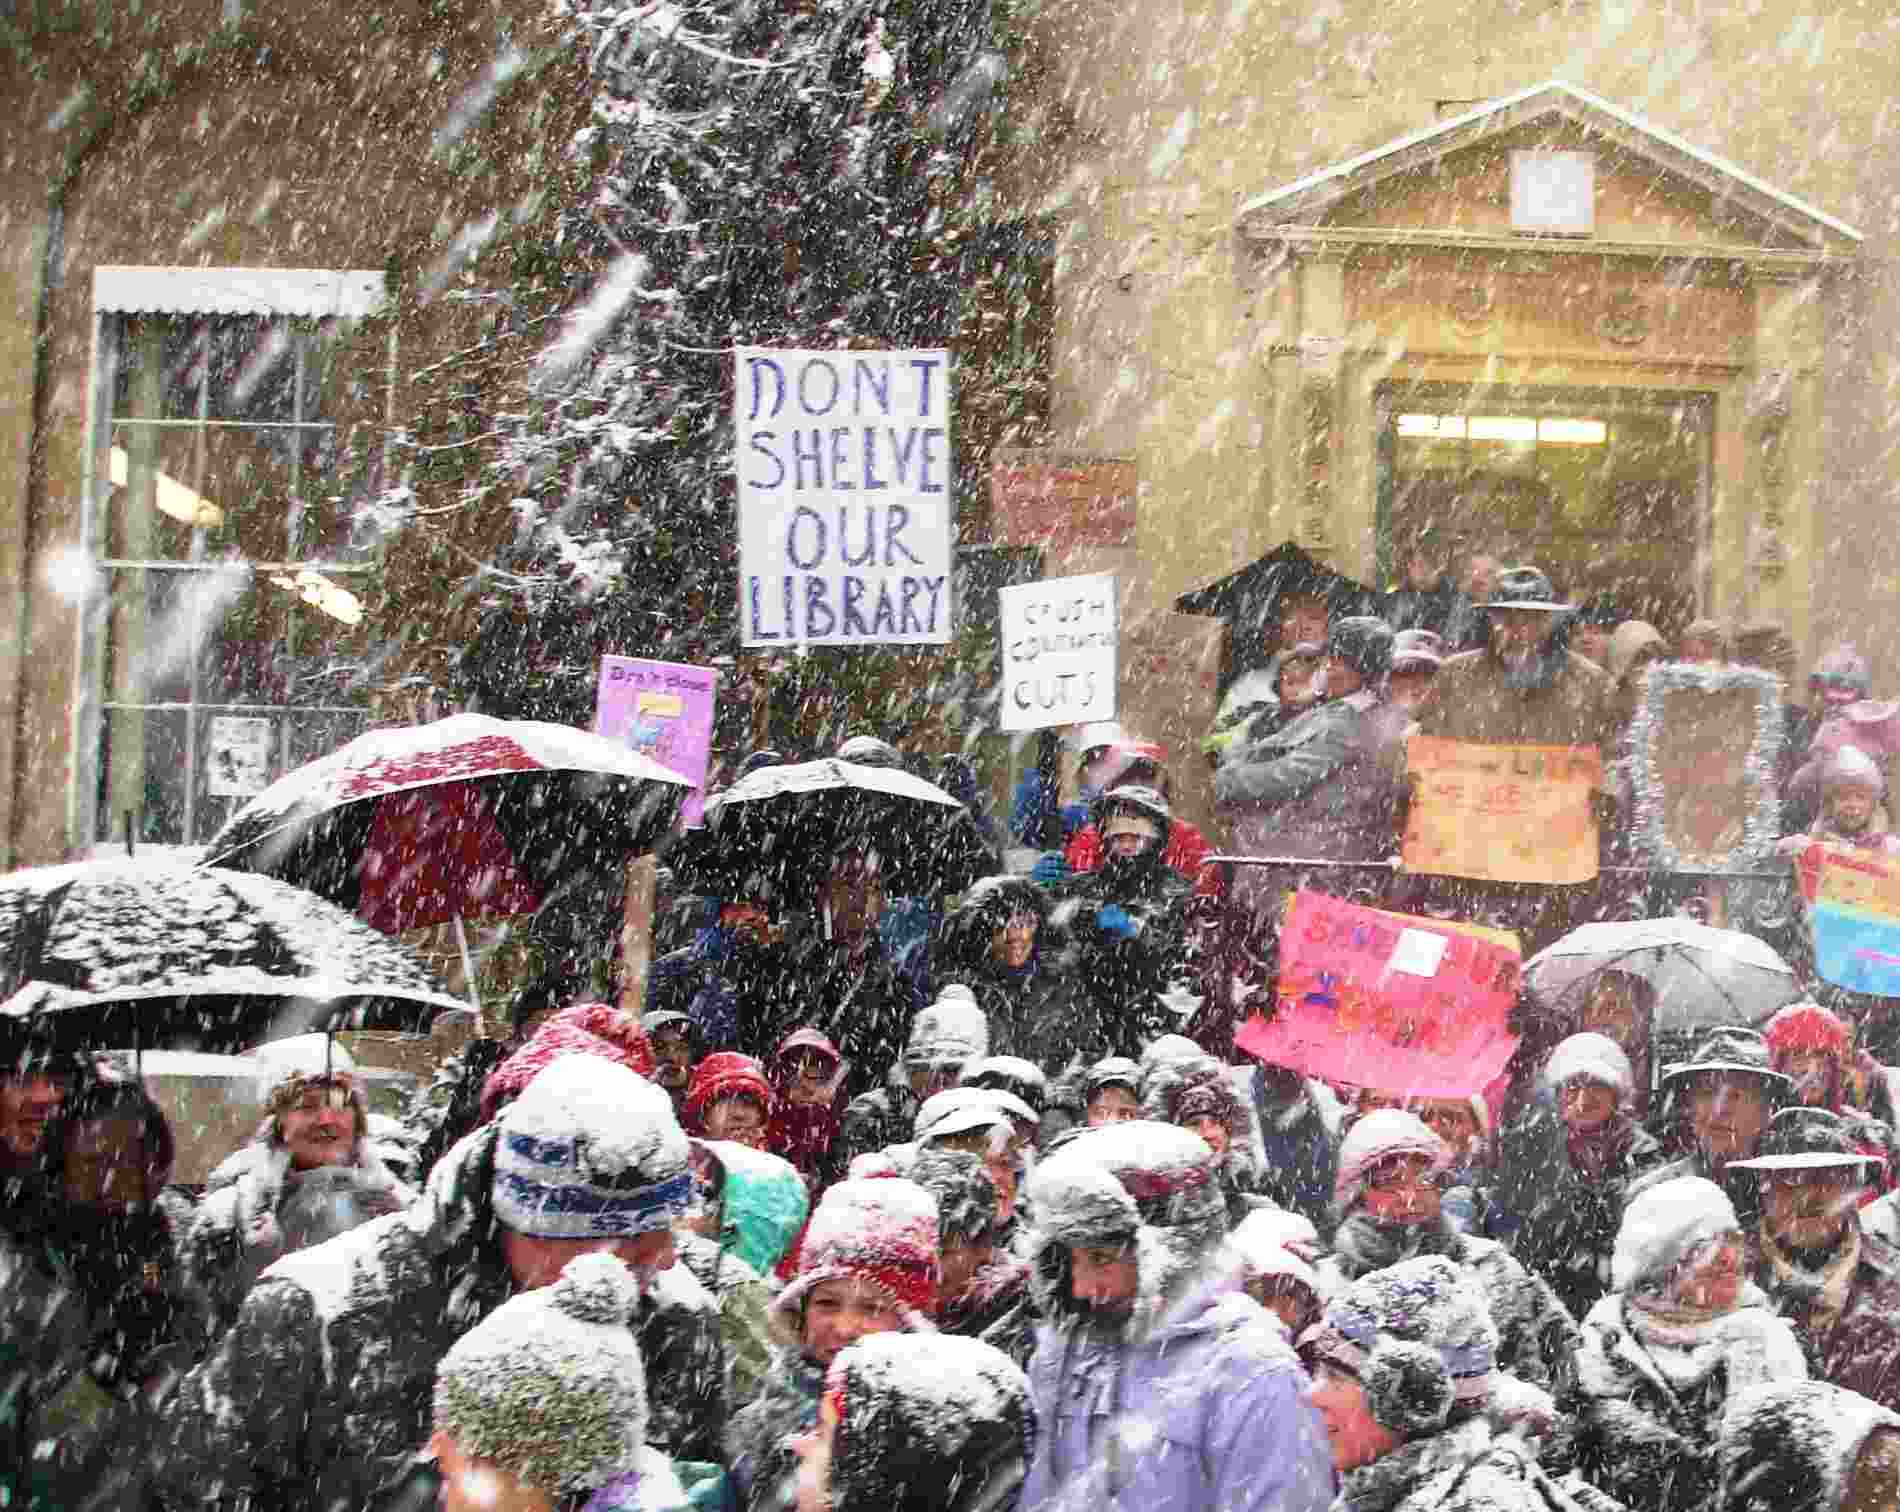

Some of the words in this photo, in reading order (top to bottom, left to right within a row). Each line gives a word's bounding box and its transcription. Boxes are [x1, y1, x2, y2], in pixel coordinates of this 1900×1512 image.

[747, 426, 944, 493] SHELVE
[787, 504, 925, 570] OUR
[750, 576, 944, 640] LIBRARY
[1013, 670, 1096, 711] CUTS
